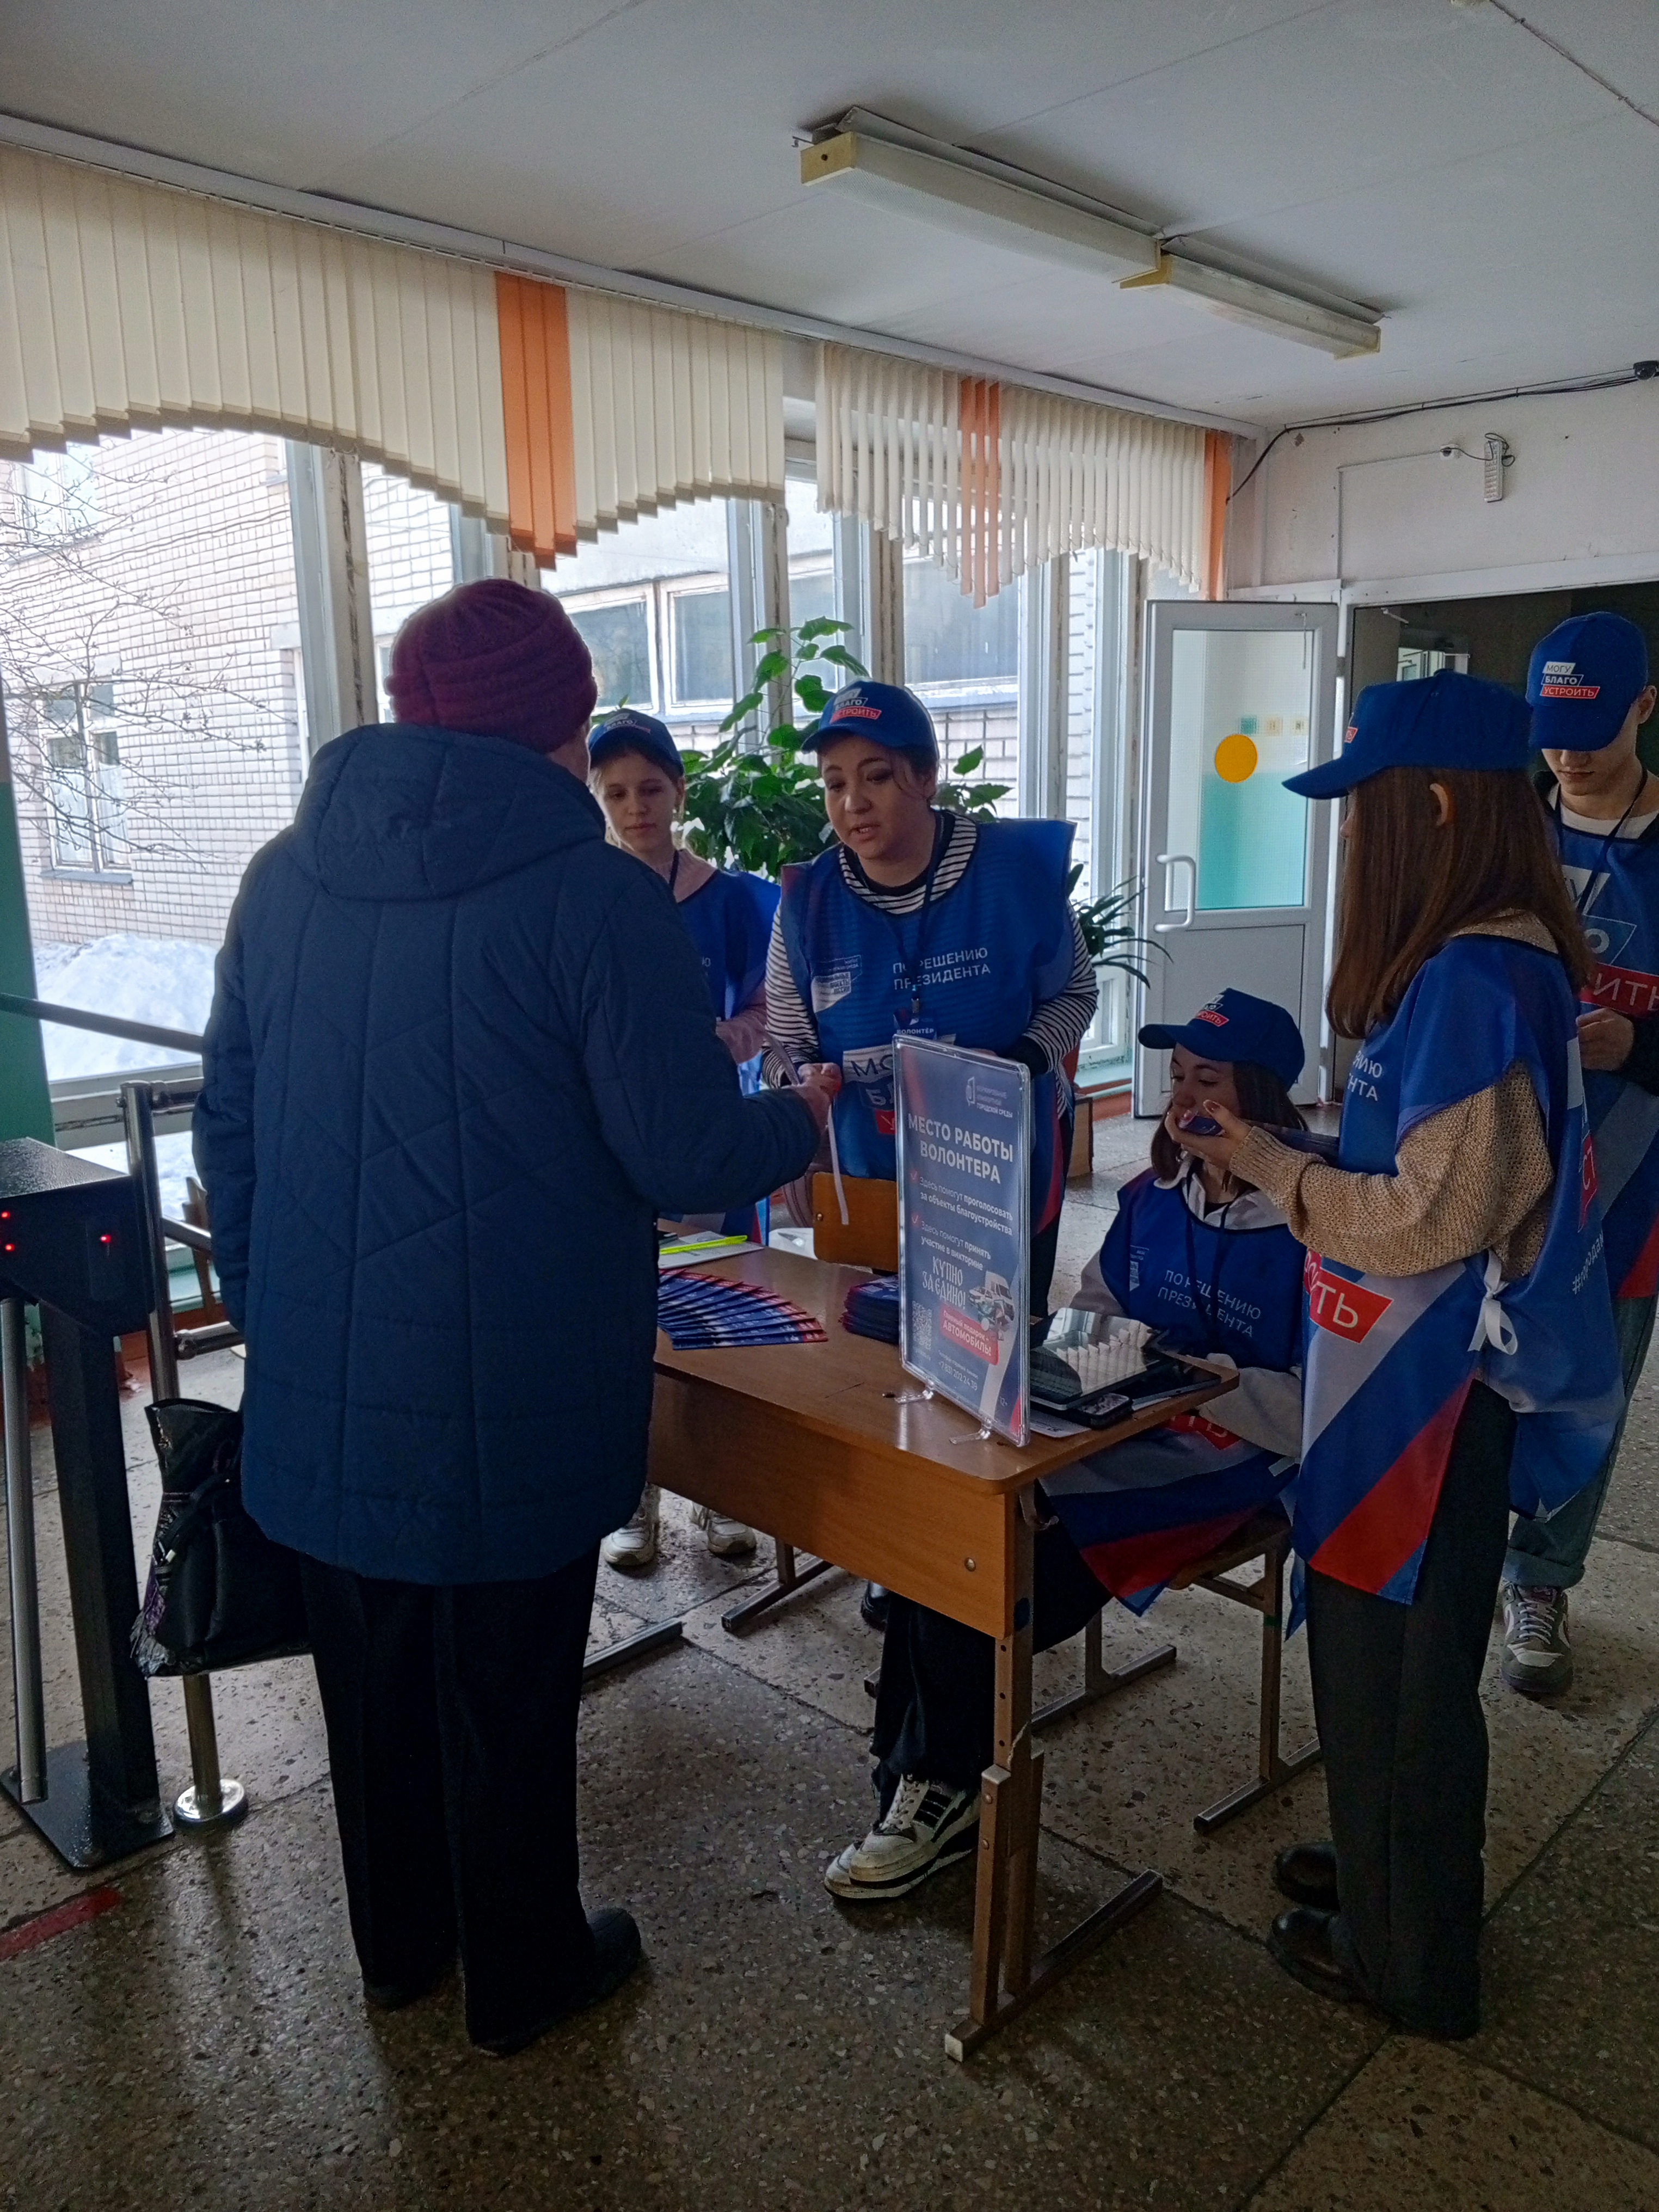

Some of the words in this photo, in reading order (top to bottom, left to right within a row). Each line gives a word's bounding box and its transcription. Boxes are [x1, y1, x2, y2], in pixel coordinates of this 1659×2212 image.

[1545, 675, 1578, 685] БЛАГО
[1546, 665, 1571, 673] МОГУ
[838, 699, 862, 708] ЛАГО
[1544, 686, 1595, 697] УСТРОИТЬ
[908, 1113, 951, 1141] МЕСТО
[955, 1127, 1013, 1163] РАБОТЫ
[920, 1140, 1001, 1184] ВОЛОНТЕРА
[919, 1176, 938, 1191] Здесь
[963, 1195, 1013, 1221] проголосовать
[920, 1192, 927, 1202] за
[929, 1195, 956, 1212] объекты
[956, 1204, 1013, 1236] благоустройства
[964, 1240, 991, 1260] принять
[932, 1256, 963, 1287] КУПНО
[1165, 1269, 1183, 1286] ПО
[942, 1320, 992, 1356] АВТОМОБИЛЬ!
